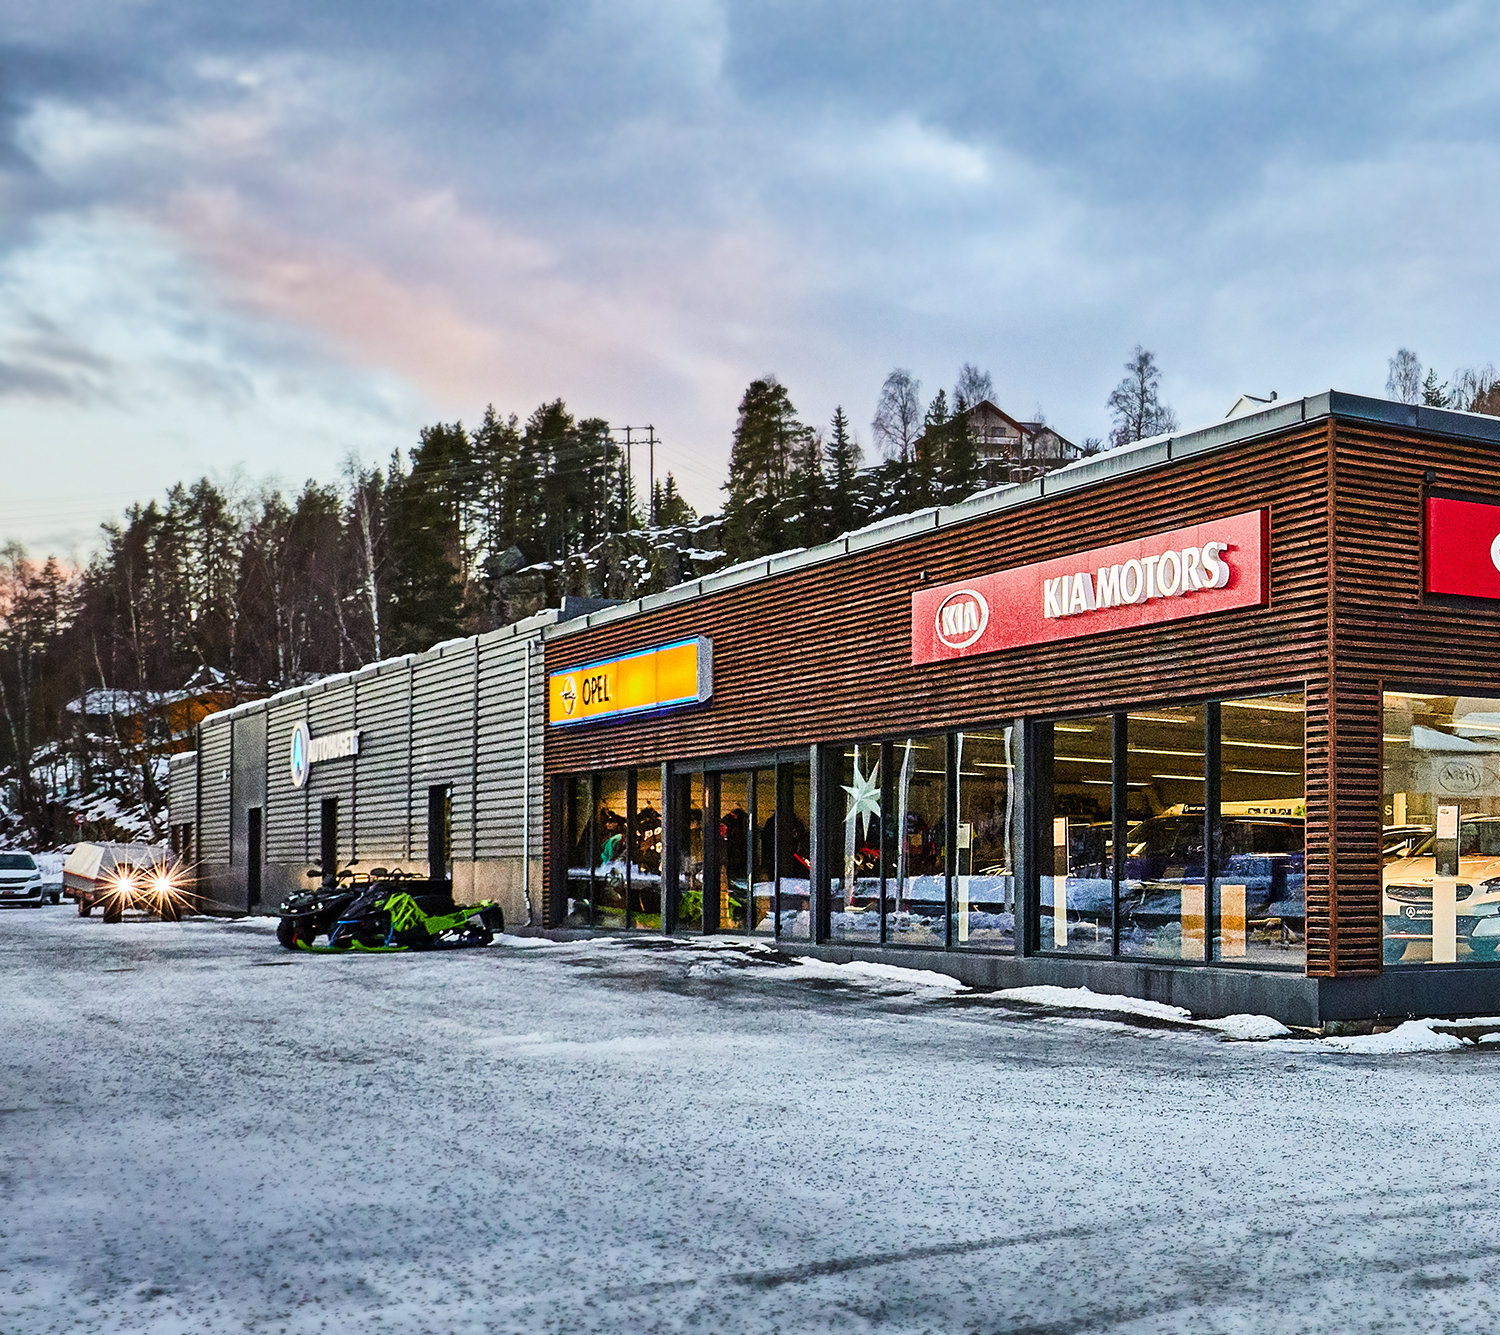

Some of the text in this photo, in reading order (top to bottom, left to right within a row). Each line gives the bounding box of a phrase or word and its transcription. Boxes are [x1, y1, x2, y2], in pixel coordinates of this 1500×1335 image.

[1043, 541, 1231, 619] KIA MOTORS
[942, 601, 979, 637] KIA
[582, 674, 610, 706] OPEL
